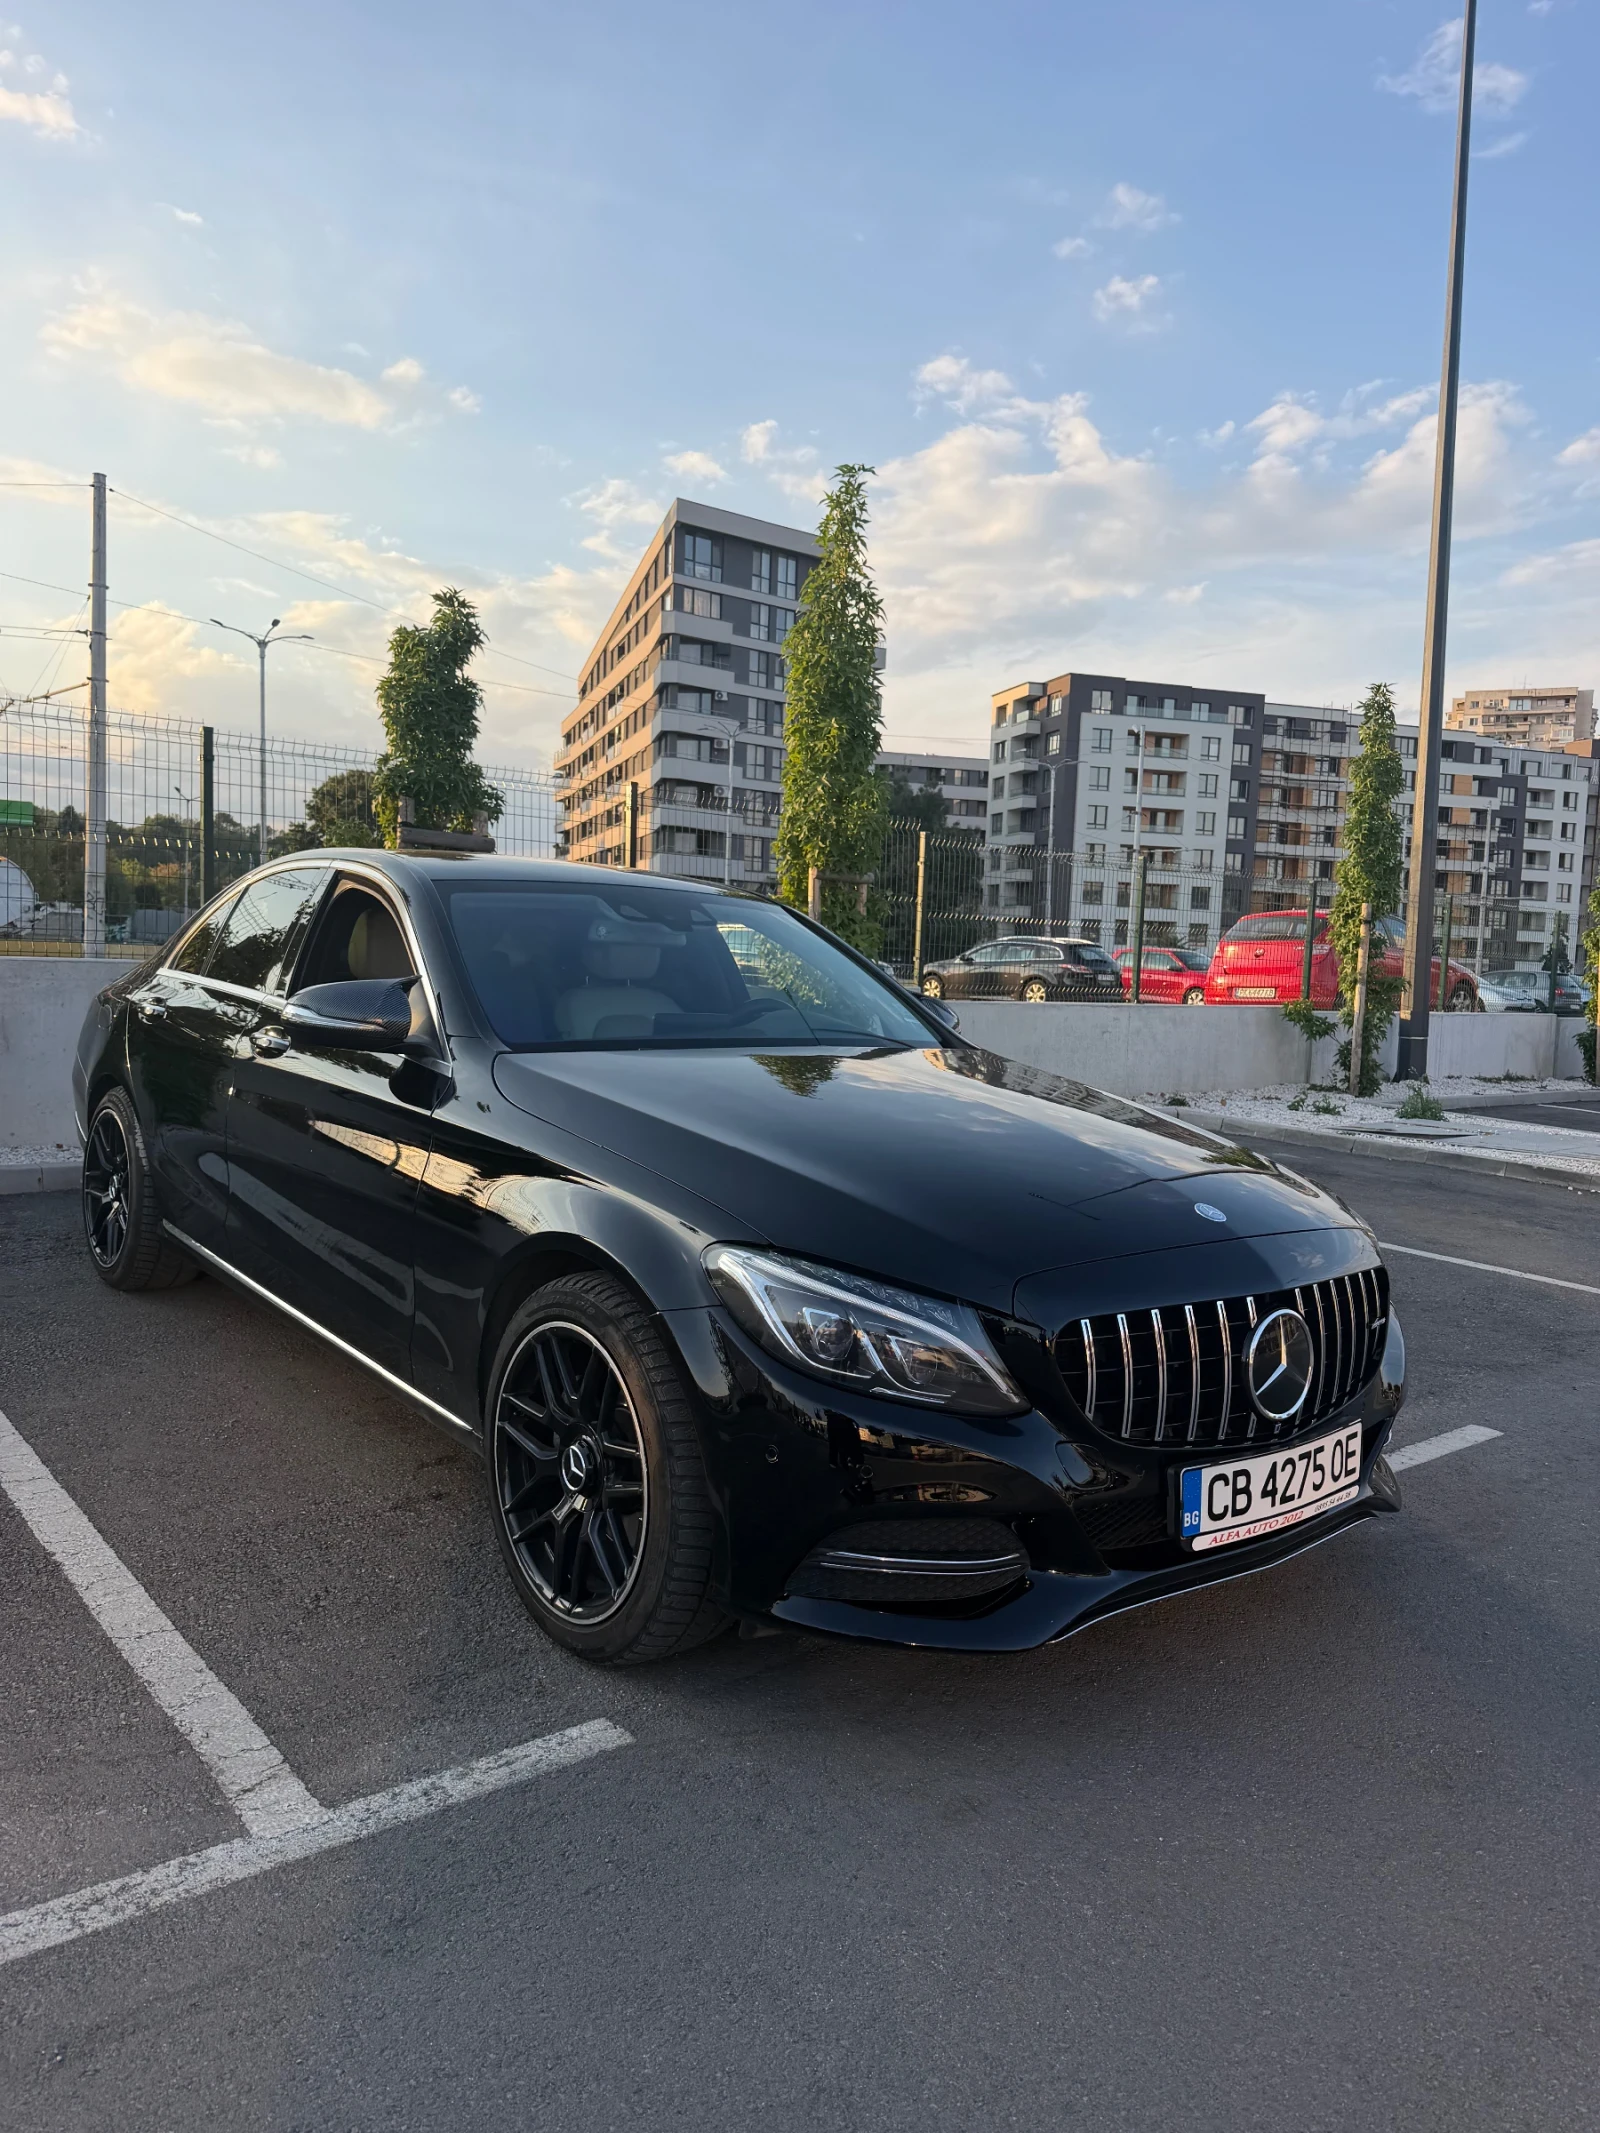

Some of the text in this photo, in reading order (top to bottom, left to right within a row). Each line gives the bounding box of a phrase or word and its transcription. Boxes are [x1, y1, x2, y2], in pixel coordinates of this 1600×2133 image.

[1207, 1431, 1359, 1522] CB 4275 OE
[1184, 1510, 1200, 1528] BG
[1208, 1531, 1241, 1546] ALFA
[1242, 1519, 1279, 1537] AUTO
[1280, 1510, 1304, 1526] 2012
